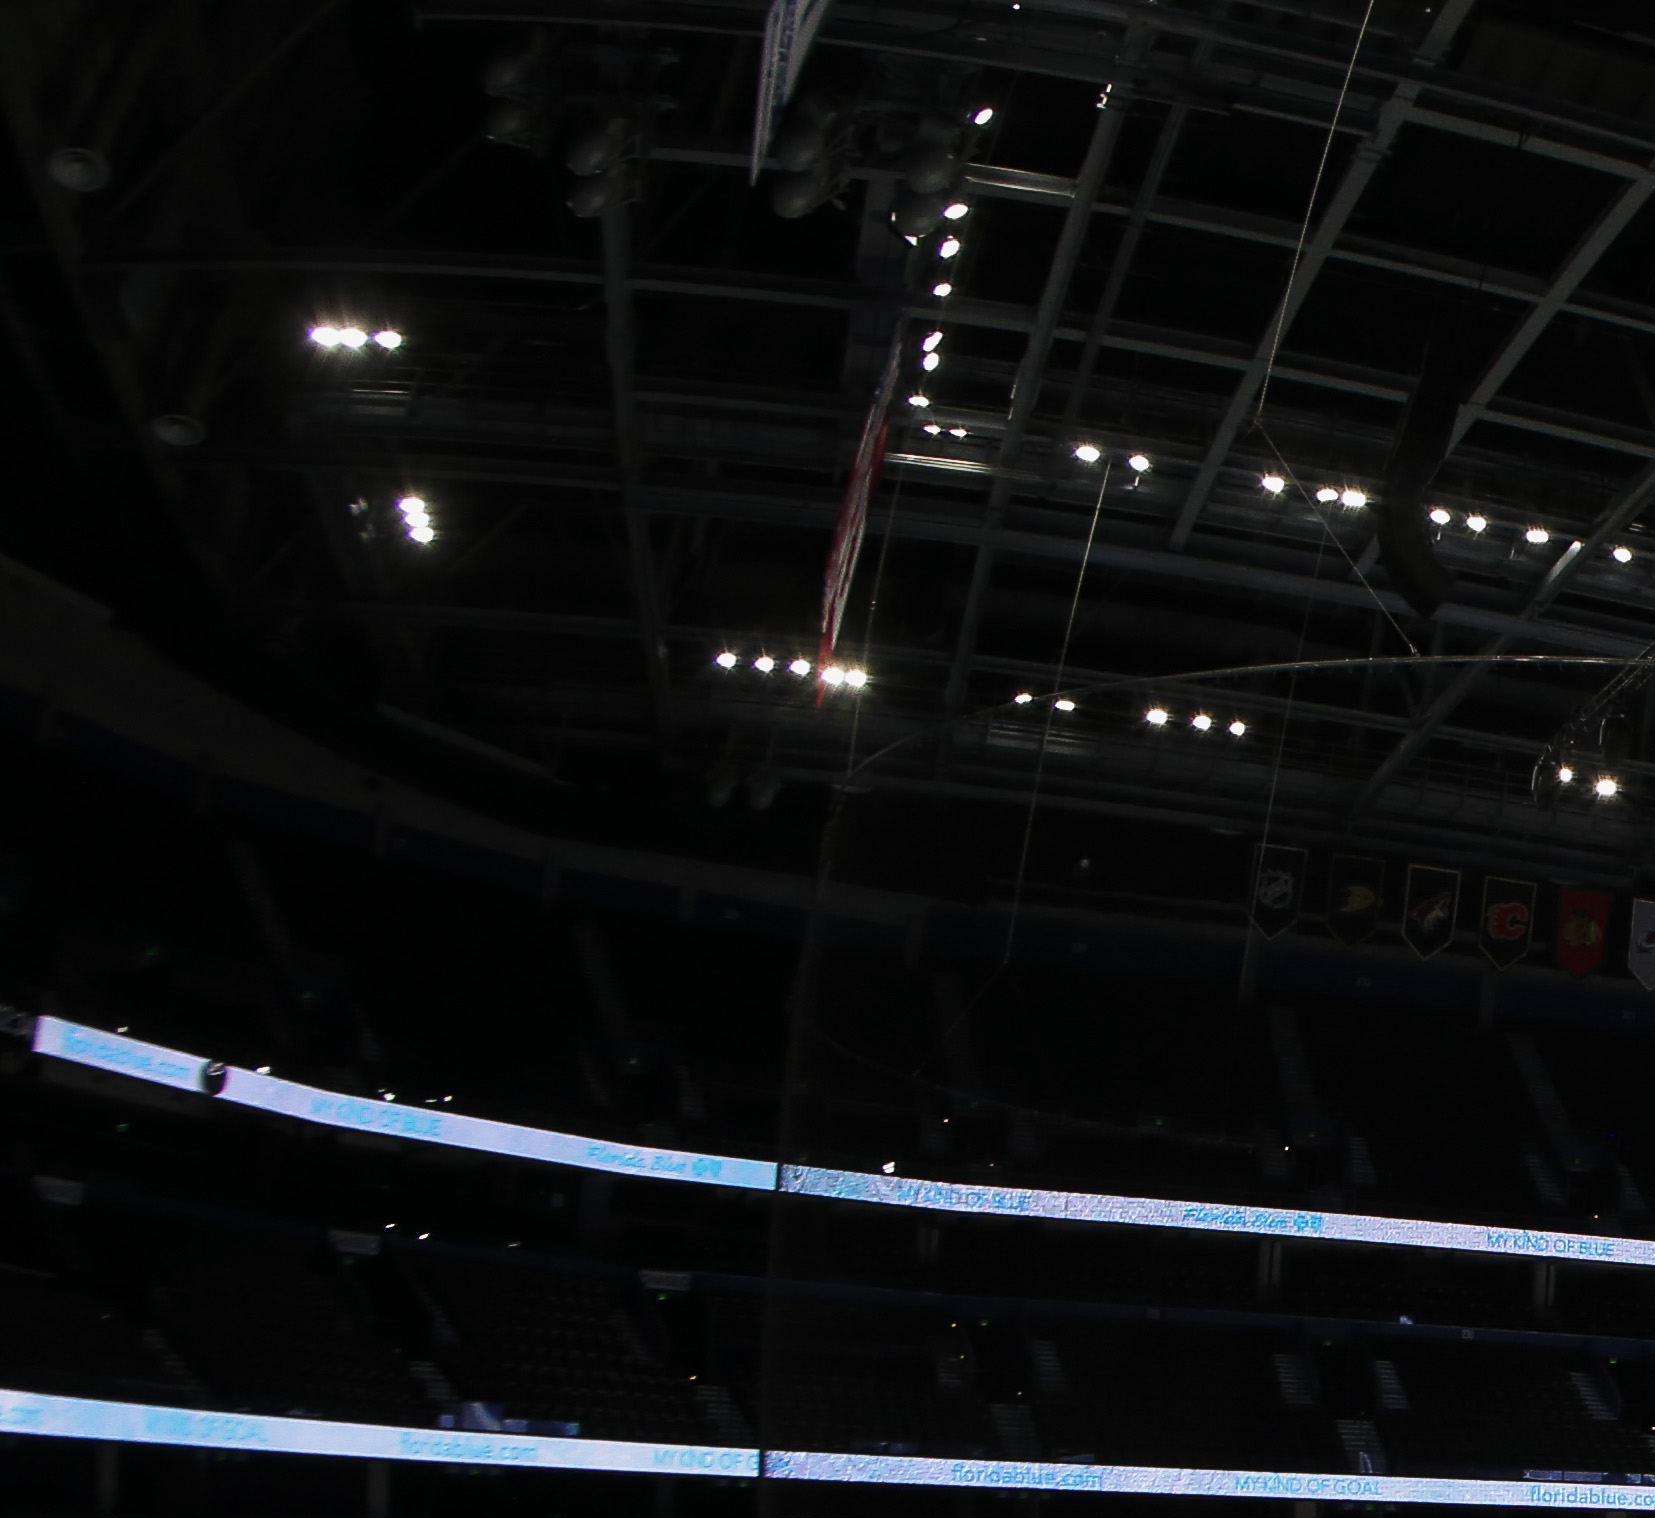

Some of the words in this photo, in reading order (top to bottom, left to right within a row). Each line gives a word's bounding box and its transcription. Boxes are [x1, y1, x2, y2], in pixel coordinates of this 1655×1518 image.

[1486, 1232, 1508, 1249] MY
[1513, 1229, 1549, 1252] KIND
[1553, 1238, 1575, 1254] OF
[1579, 1241, 1615, 1257] BLUE
[1307, 1479, 1329, 1494] OF
[1332, 1479, 1383, 1496] GOAL
